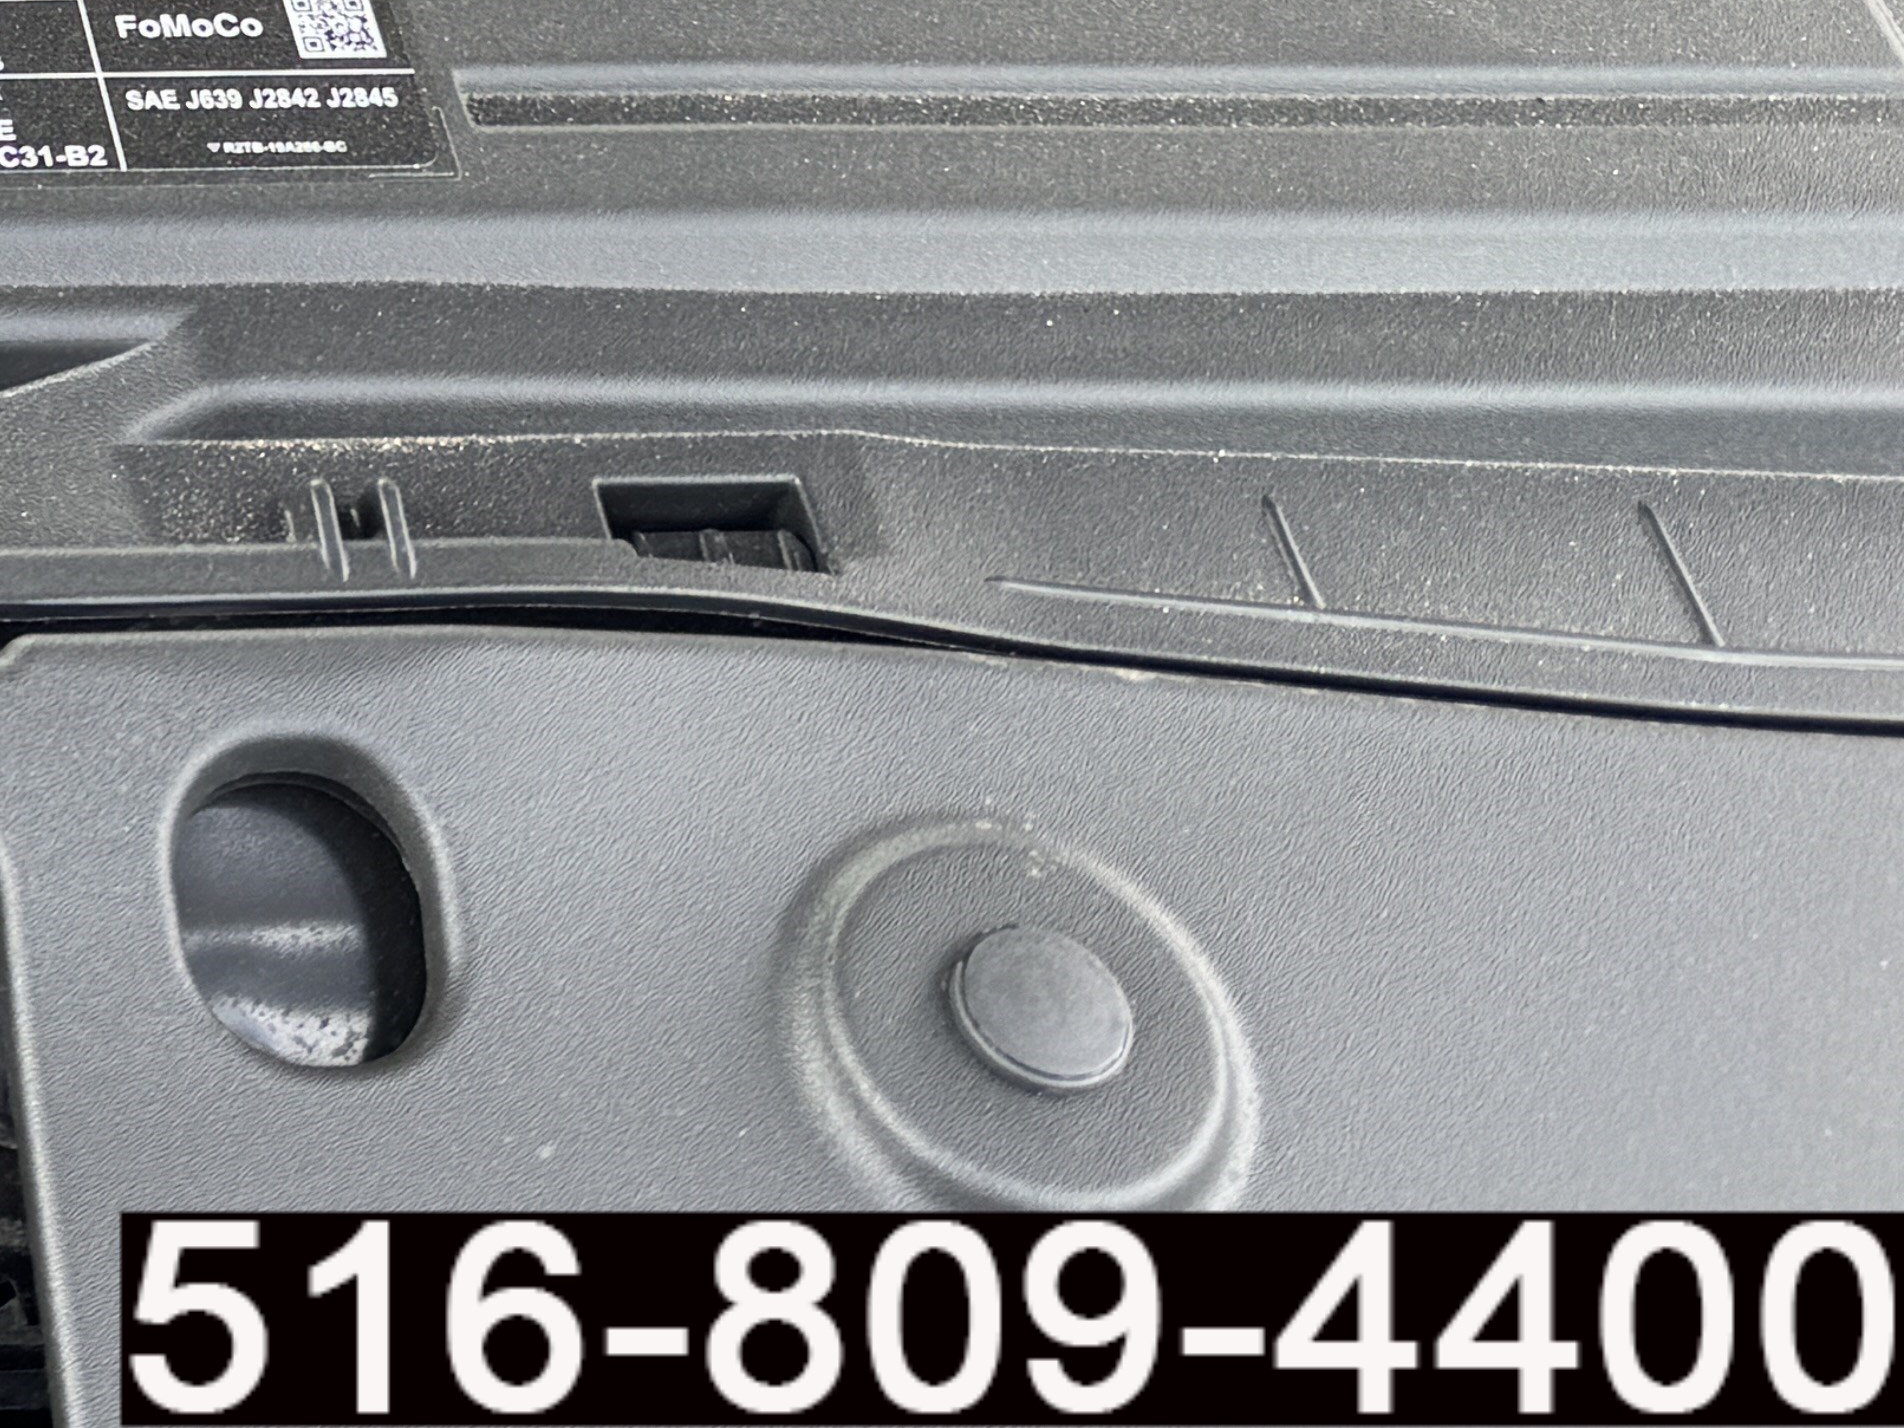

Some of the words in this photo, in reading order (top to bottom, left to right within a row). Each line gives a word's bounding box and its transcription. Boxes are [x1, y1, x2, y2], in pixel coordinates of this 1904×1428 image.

[114, 12, 264, 39] FoMoCo
[125, 89, 180, 111] SAE
[185, 88, 243, 110] J639
[248, 87, 321, 109] J2842
[326, 86, 399, 109] J2845
